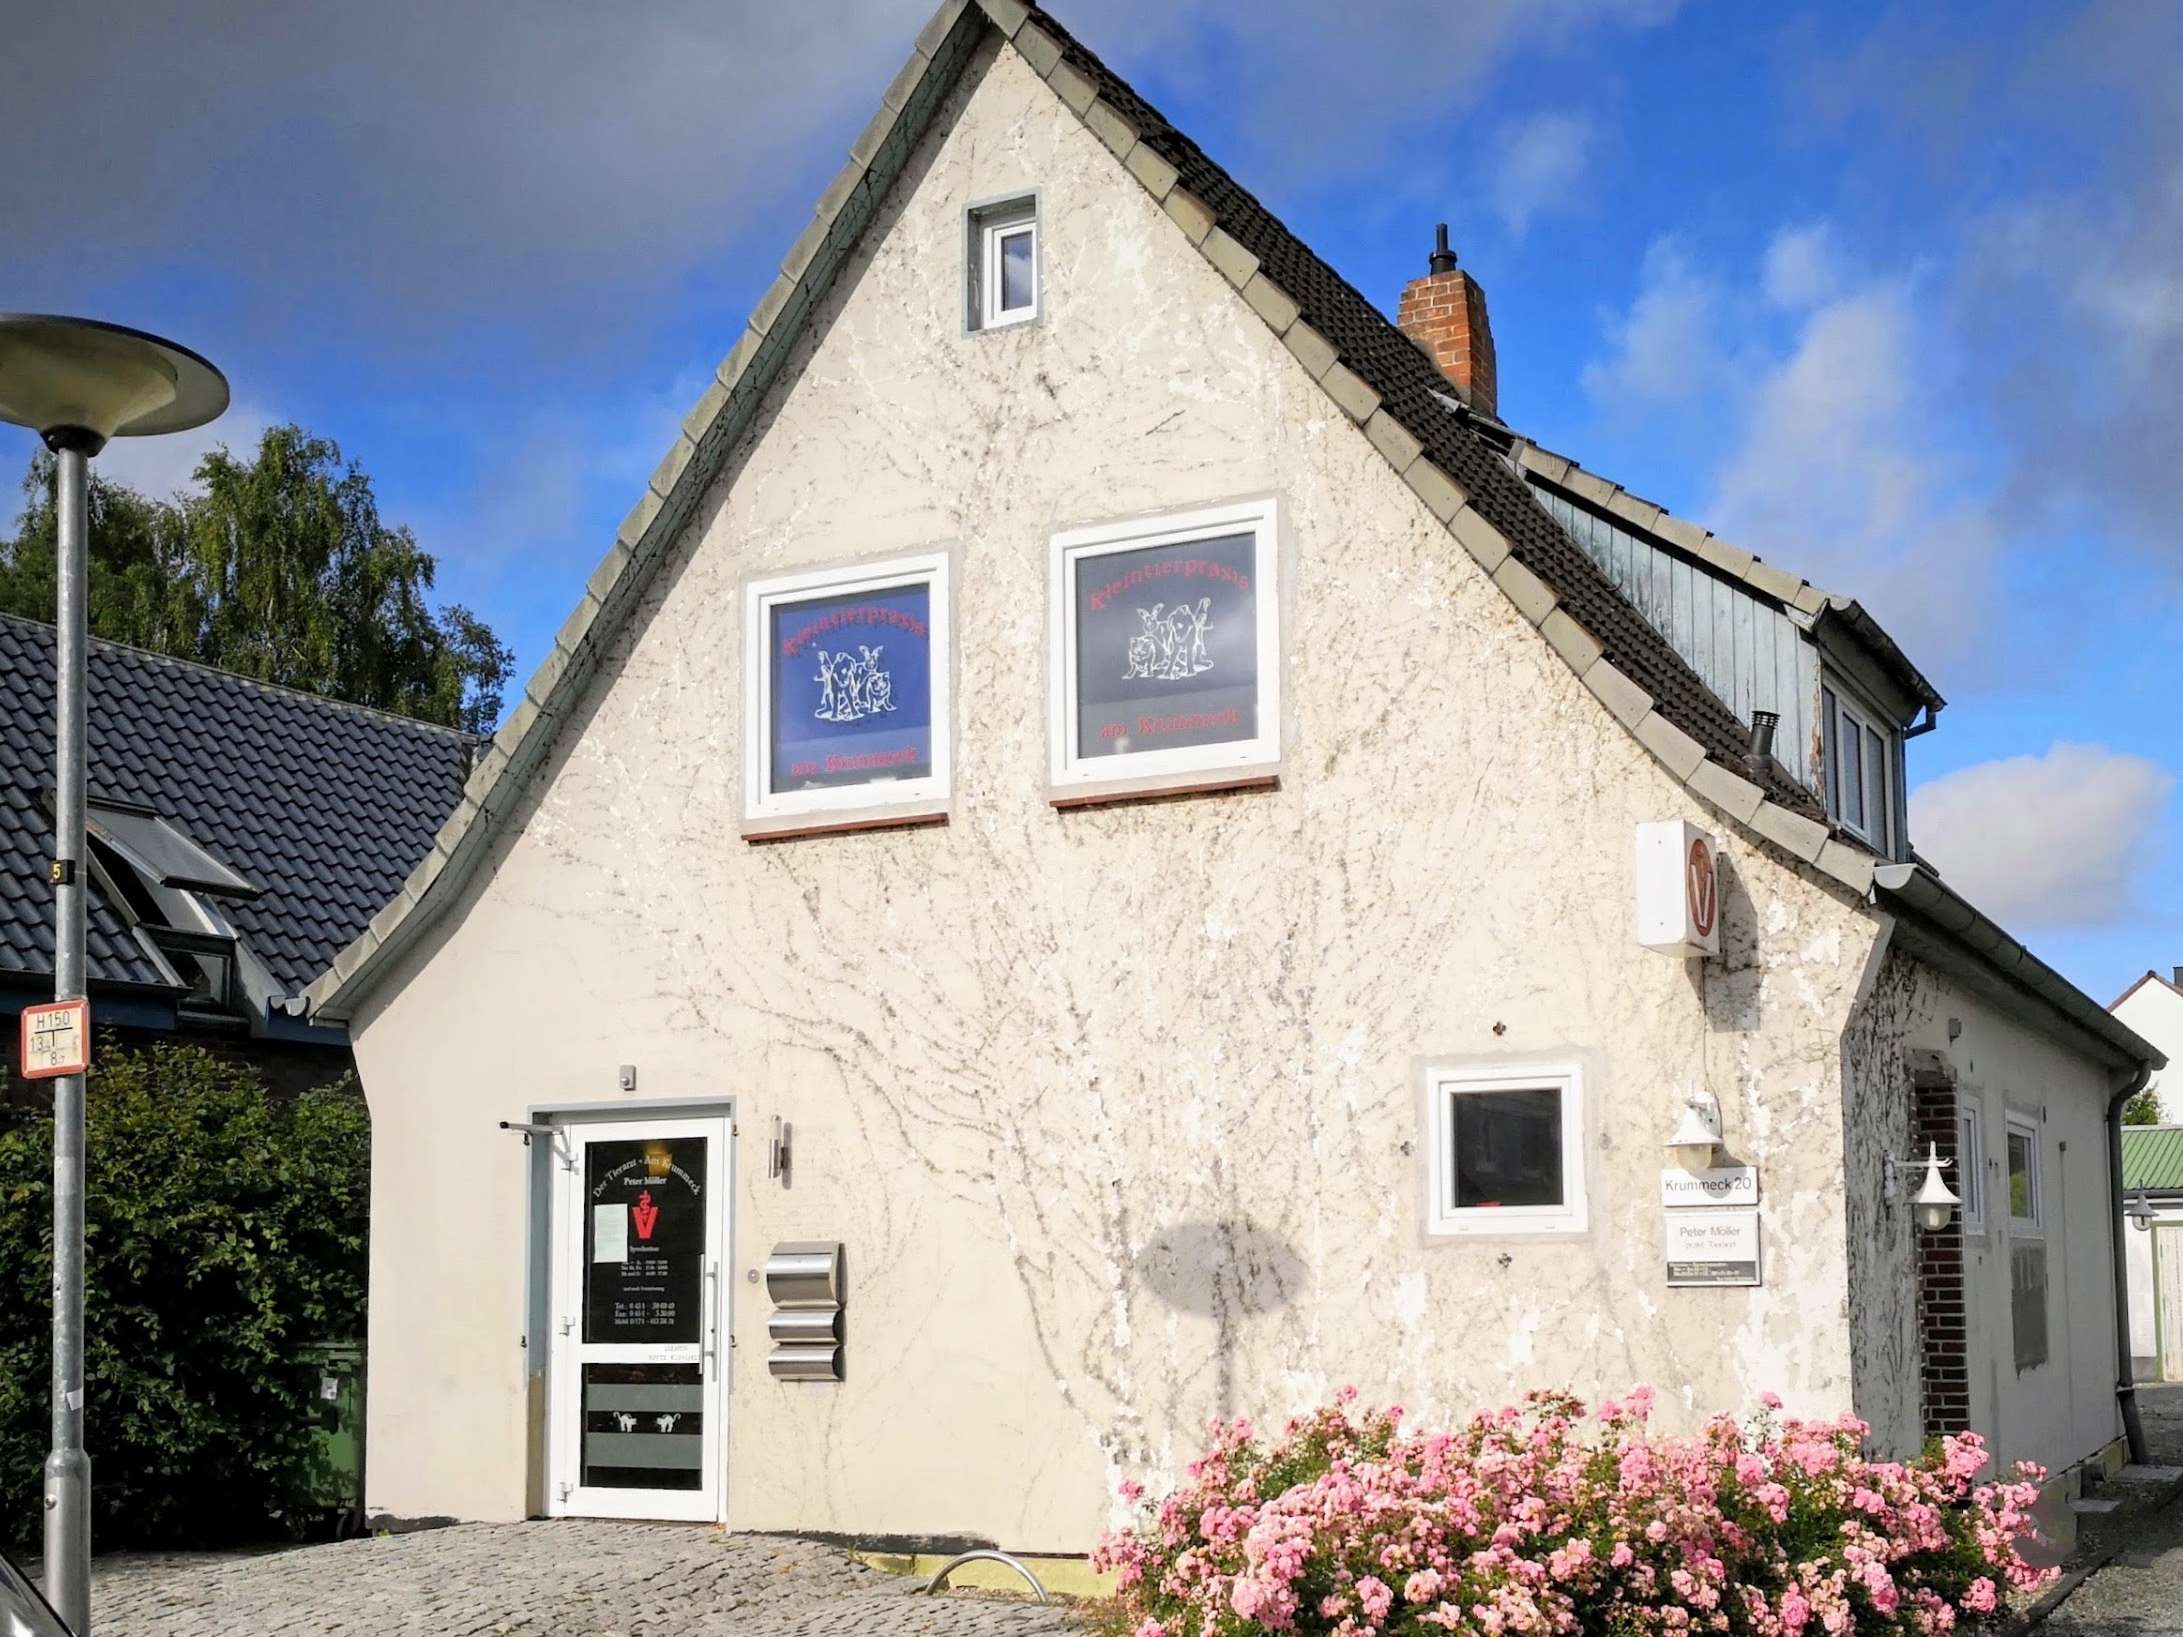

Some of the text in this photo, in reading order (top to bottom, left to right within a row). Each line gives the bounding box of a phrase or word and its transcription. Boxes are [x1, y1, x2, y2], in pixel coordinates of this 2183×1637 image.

[53, 863, 61, 879] 5
[592, 1180, 608, 1198] Der
[605, 1158, 637, 1181] Tierarzt
[661, 1157, 701, 1196] Krummeck
[623, 1177, 643, 1186] Peter
[1665, 1176, 1752, 1191] Krummeck 20
[1680, 1226, 1706, 1238] Peter
